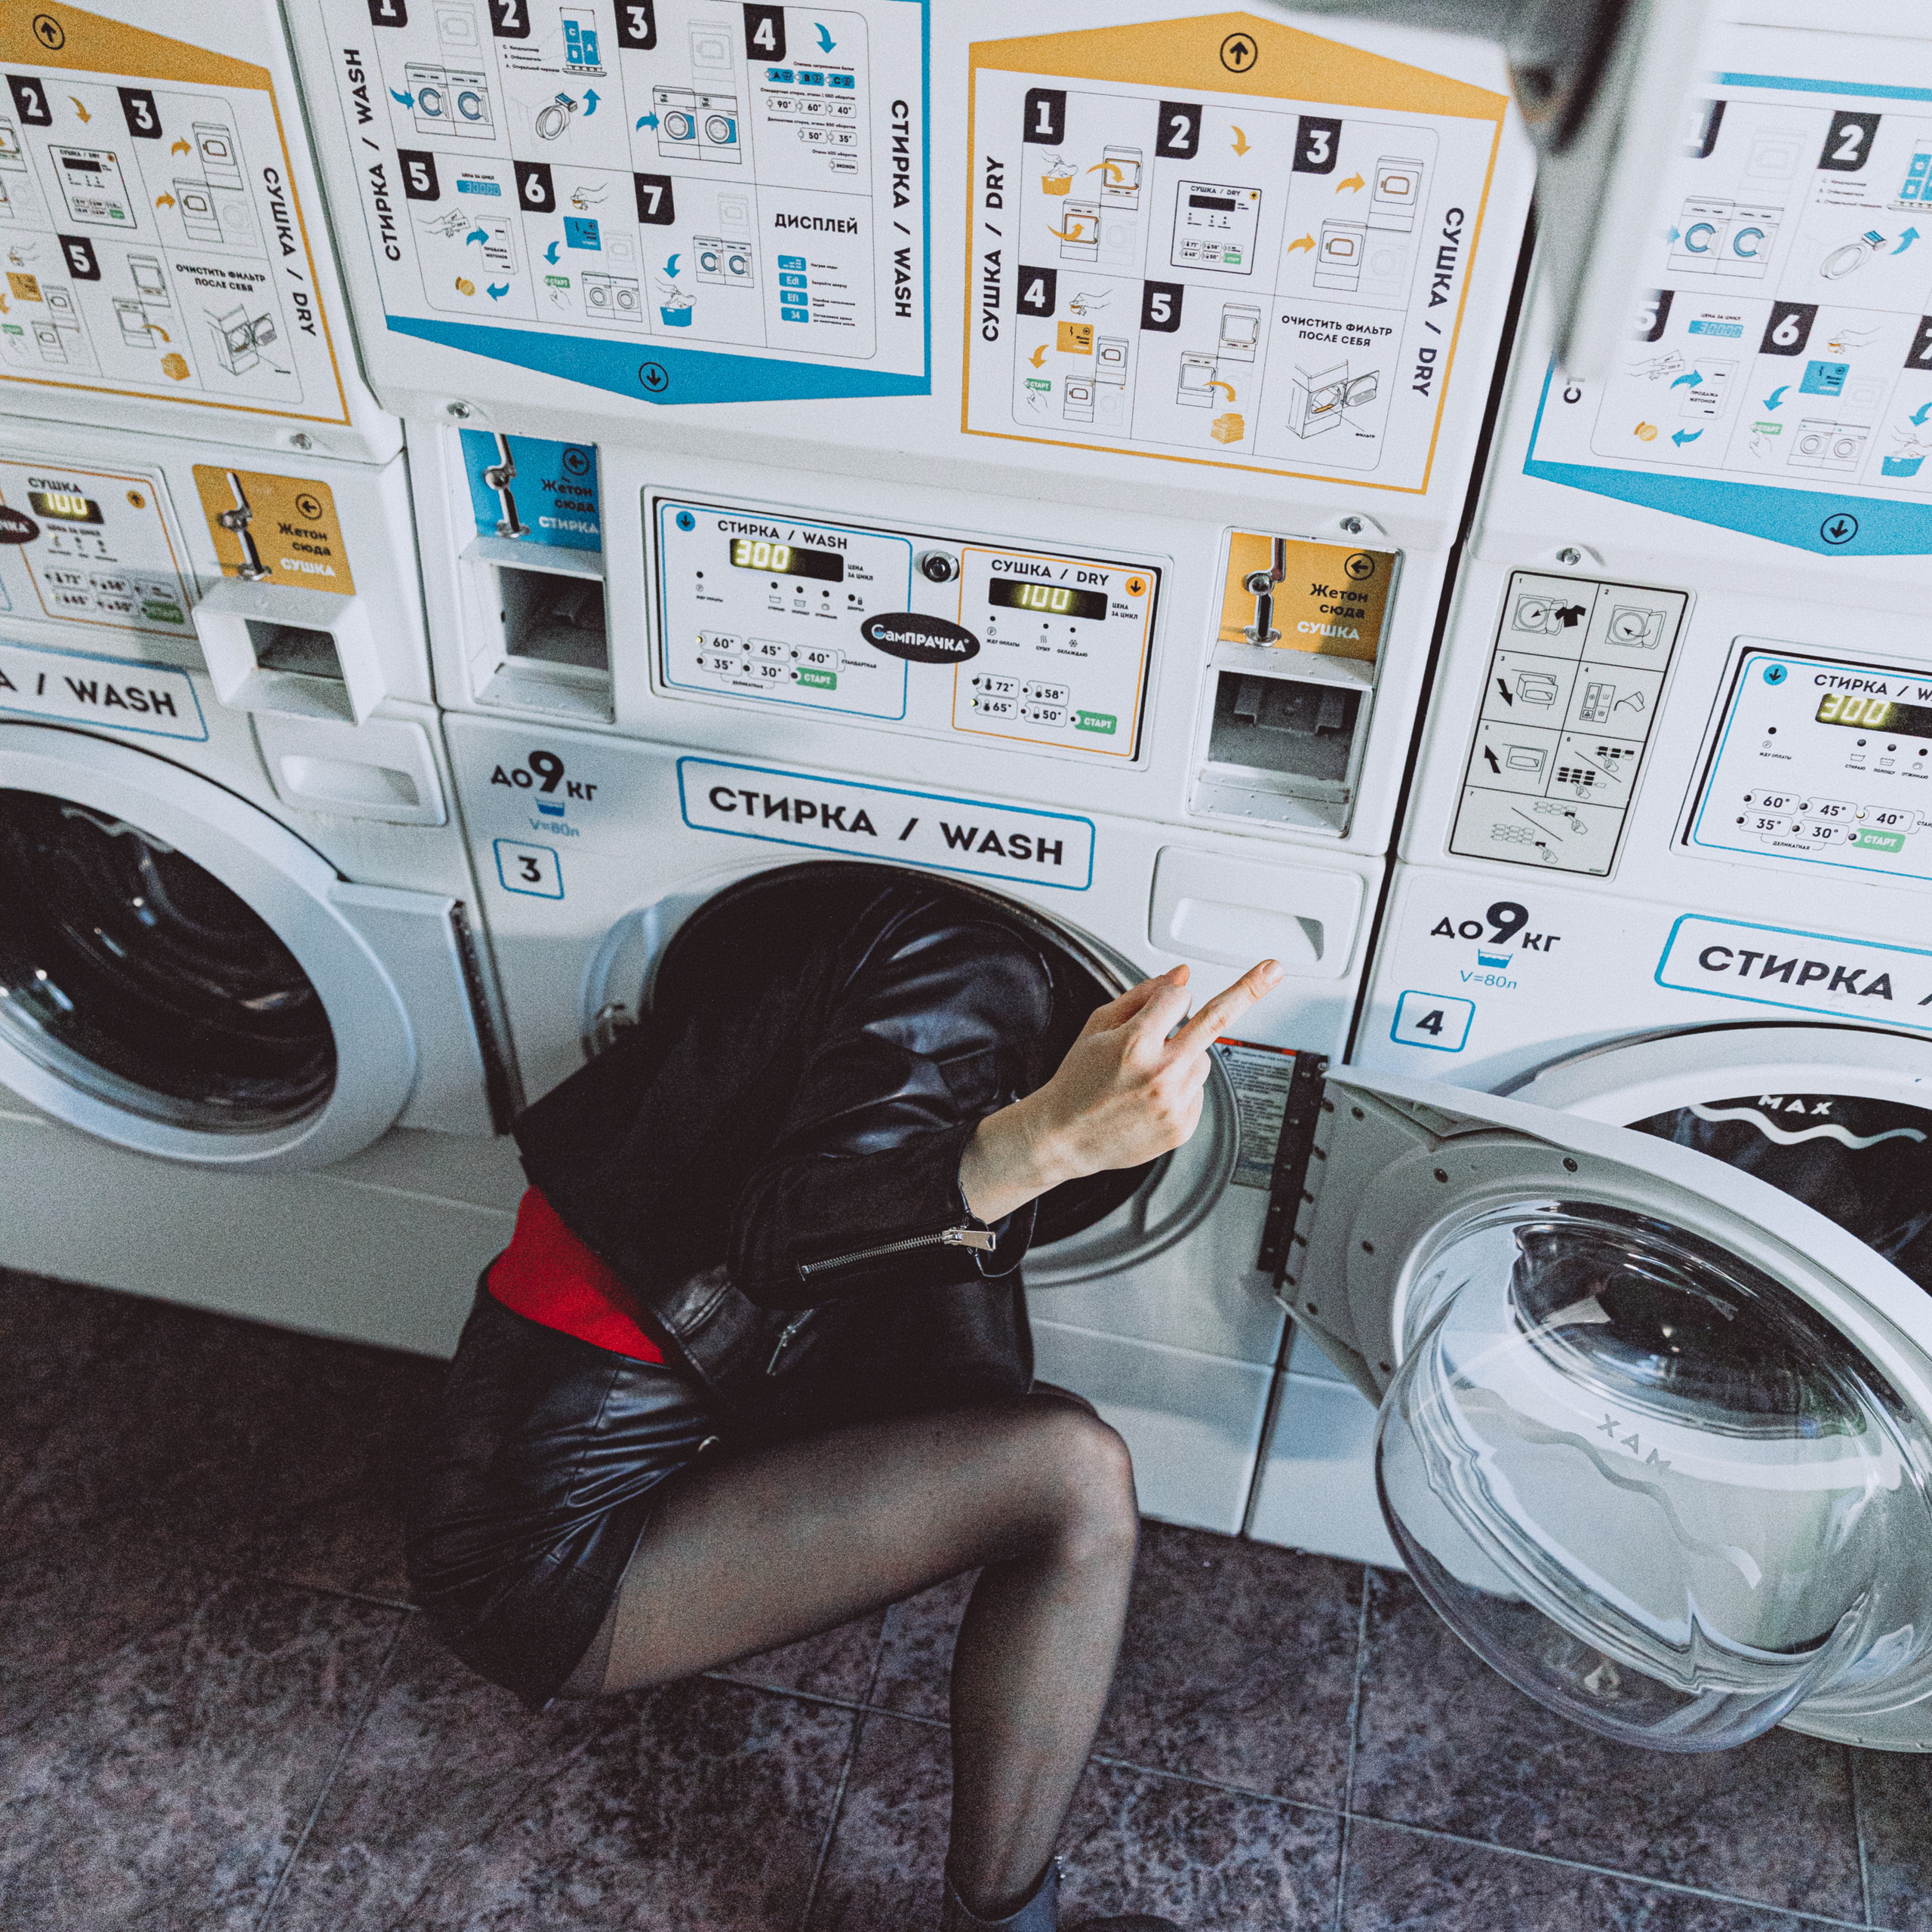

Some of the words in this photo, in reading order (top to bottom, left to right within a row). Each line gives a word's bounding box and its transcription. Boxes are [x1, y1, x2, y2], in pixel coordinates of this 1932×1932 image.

[499, 0, 520, 28] 2
[626, 6, 648, 39] 3
[753, 18, 776, 51] 4
[343, 49, 374, 125] WASH
[21, 87, 43, 116] 2
[777, 100, 791, 109] 90°
[808, 103, 821, 112] 60°
[131, 99, 153, 129] 3
[1035, 101, 1054, 134] 1
[808, 132, 822, 140] 50°
[1168, 115, 1192, 149] 2
[361, 137, 380, 151] /
[1306, 130, 1331, 164] 3
[1832, 124, 1864, 161] 2
[891, 100, 910, 208] СТИРКА
[408, 162, 430, 192] 5
[986, 155, 1004, 210] DRY
[525, 173, 546, 203] 6
[643, 185, 663, 215] 7
[263, 167, 297, 257] СУШКА
[368, 163, 401, 261] СТИРКА
[774, 214, 858, 234] ДИСПЛЕЙ
[894, 221, 911, 235] /
[985, 223, 1002, 237] /
[69, 245, 91, 272] 5
[1428, 208, 1464, 308] СУШКА
[176, 264, 226, 277] ОЧИСТИТЬ
[228, 272, 266, 282] ФИЛЬТР
[287, 268, 303, 281] /
[894, 247, 912, 318] WASH
[195, 278, 227, 288] ПОСЛЕ
[229, 282, 254, 293] СЕБЯ
[982, 249, 1001, 341] СУШКА
[1023, 279, 1046, 308] 4
[292, 292, 317, 337] DRY
[1150, 293, 1171, 323] 5
[1281, 315, 1343, 330] ОЧИСТИТЬ
[1346, 324, 1392, 336] ФИЛЬТР
[1425, 321, 1441, 334] /
[1772, 314, 1799, 346] 6
[1299, 331, 1338, 343] ПОСЛЕ
[1341, 336, 1371, 347] СЕБЯ
[1412, 347, 1438, 397] DRY
[28, 477, 82, 494] СУШКА
[541, 478, 592, 497] Жетон
[47, 493, 88, 515] 100
[555, 500, 595, 512] сюда
[278, 522, 328, 542] Жетон
[539, 516, 599, 534] СТИРКА
[718, 521, 780, 540] СТИРКА
[788, 530, 795, 540] /
[803, 532, 848, 549] WASH
[292, 542, 331, 555] сюда
[736, 540, 790, 570] 300
[280, 558, 336, 577] СУШКА
[991, 559, 1052, 579] СУШКА
[1060, 569, 1069, 580] /
[1077, 571, 1109, 586] DRY
[1022, 584, 1070, 610] 100
[1310, 583, 1368, 603] Жетон
[1120, 612, 1138, 620] ЦИКЛ
[1319, 605, 1364, 619] сюда
[1297, 621, 1360, 640] СУШКА
[713, 638, 734, 648] 60°
[761, 645, 781, 656] 45°
[1057, 649, 1088, 657] ОХЛАЖДАЮ
[714, 659, 734, 670] 35°
[808, 653, 829, 663] 40°
[761, 666, 781, 678] 30°
[804, 673, 831, 685] СТАРТ
[995, 681, 1014, 692] 72°
[1044, 690, 1064, 700] 58°
[1814, 674, 1887, 694] СТИРКА
[1897, 687, 1909, 697] /
[63, 676, 177, 717] WASH
[993, 703, 1011, 712] 65°
[1042, 710, 1061, 720] 50°
[1820, 693, 1890, 724] 300
[1084, 717, 1112, 730] СТАРТ
[528, 750, 565, 793] 9
[1763, 796, 1790, 808] 60°
[1820, 804, 1846, 817] 45°
[708, 786, 878, 836] СТИРКА
[899, 818, 918, 841] /
[939, 822, 1063, 866] WASH
[1756, 818, 1782, 830] 35°
[1876, 813, 1904, 825] 40°
[1812, 826, 1838, 839] 30°
[1864, 835, 1897, 847] СТАРТ
[1772, 841, 1810, 851] ДЕЛИКАТНАЯ
[518, 856, 541, 882] 3
[1486, 901, 1529, 944] 9
[1460, 970, 1517, 989] V=80л
[1698, 946, 1893, 1001] СТИРКА
[1416, 1010, 1444, 1035] 4
[1758, 1094, 1832, 1115] MAX
